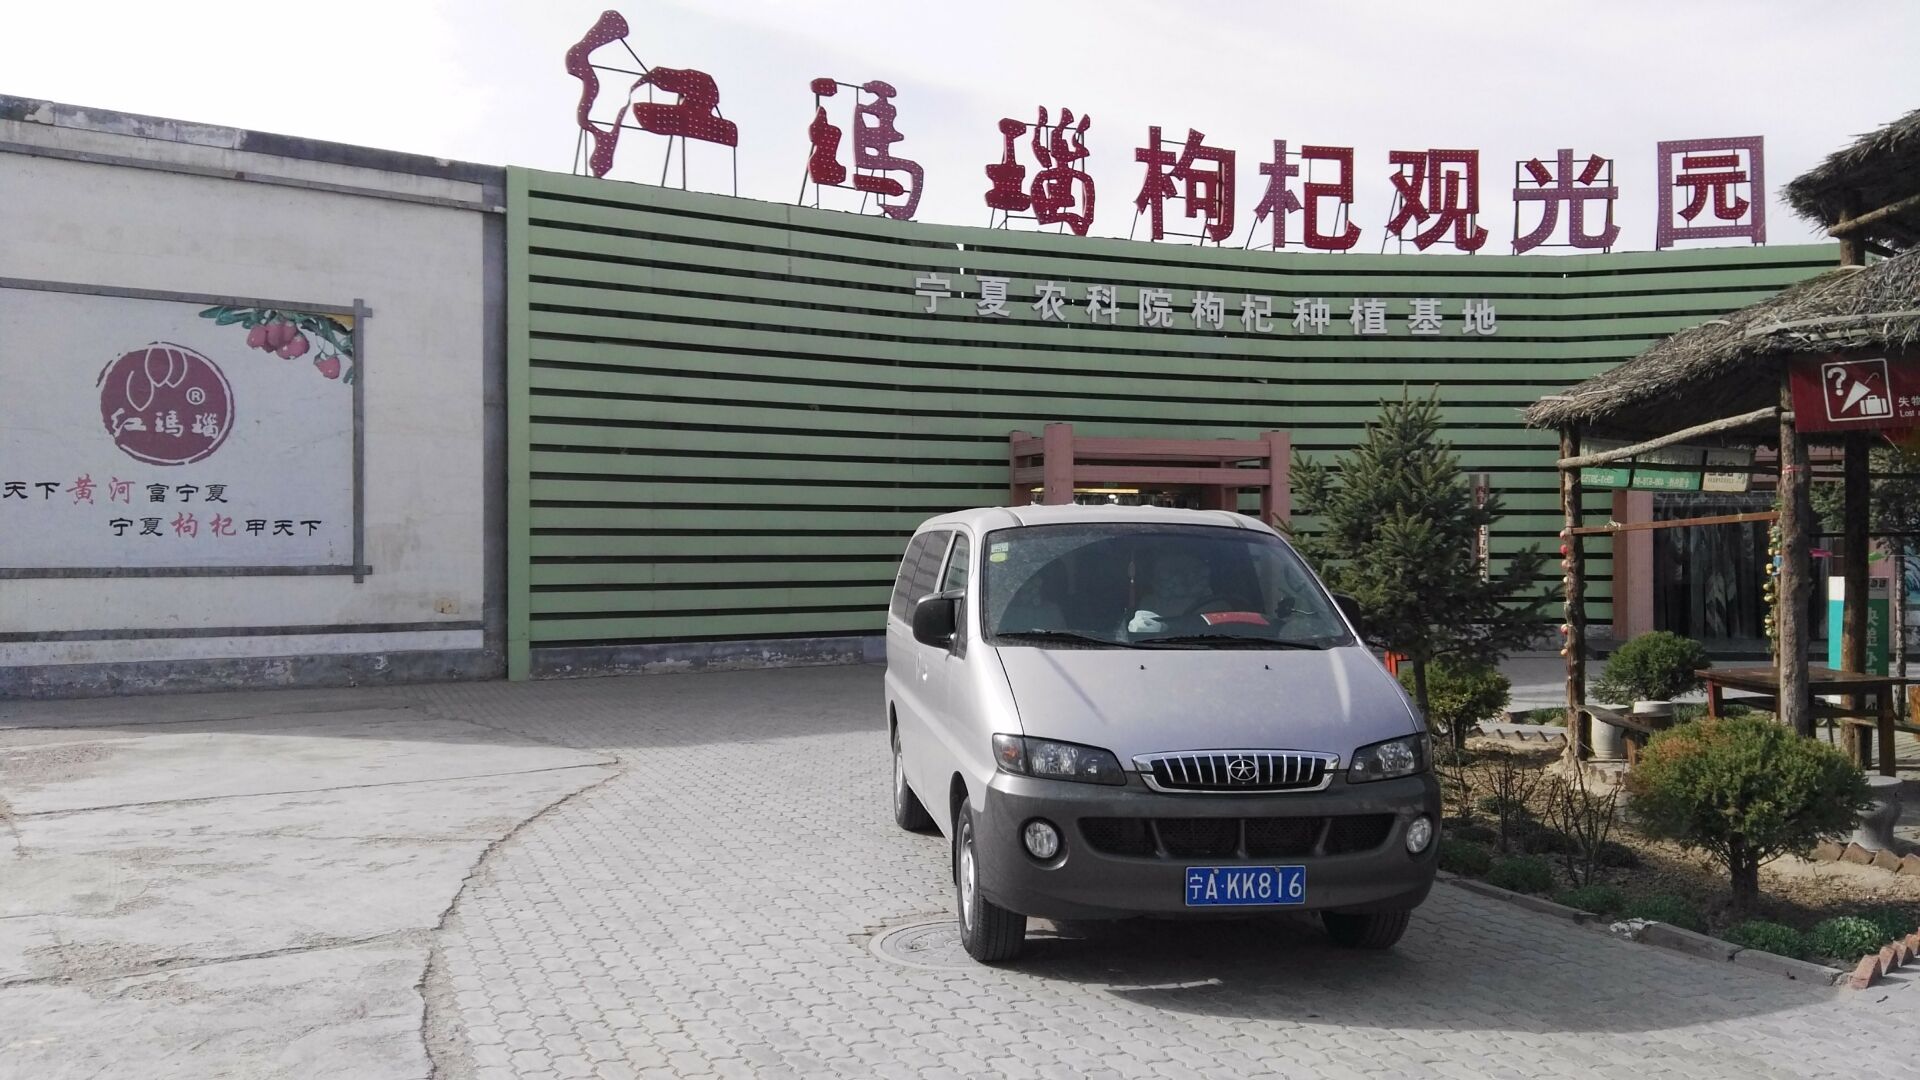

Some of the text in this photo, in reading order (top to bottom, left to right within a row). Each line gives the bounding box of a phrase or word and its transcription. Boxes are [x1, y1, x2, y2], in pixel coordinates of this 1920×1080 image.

[914, 273, 1498, 337] 宁夏农科院枸杞种植基地
[2, 474, 228, 505] 天下黄河富宁夏
[109, 512, 322, 538] 宁夏枸杞甲天下
